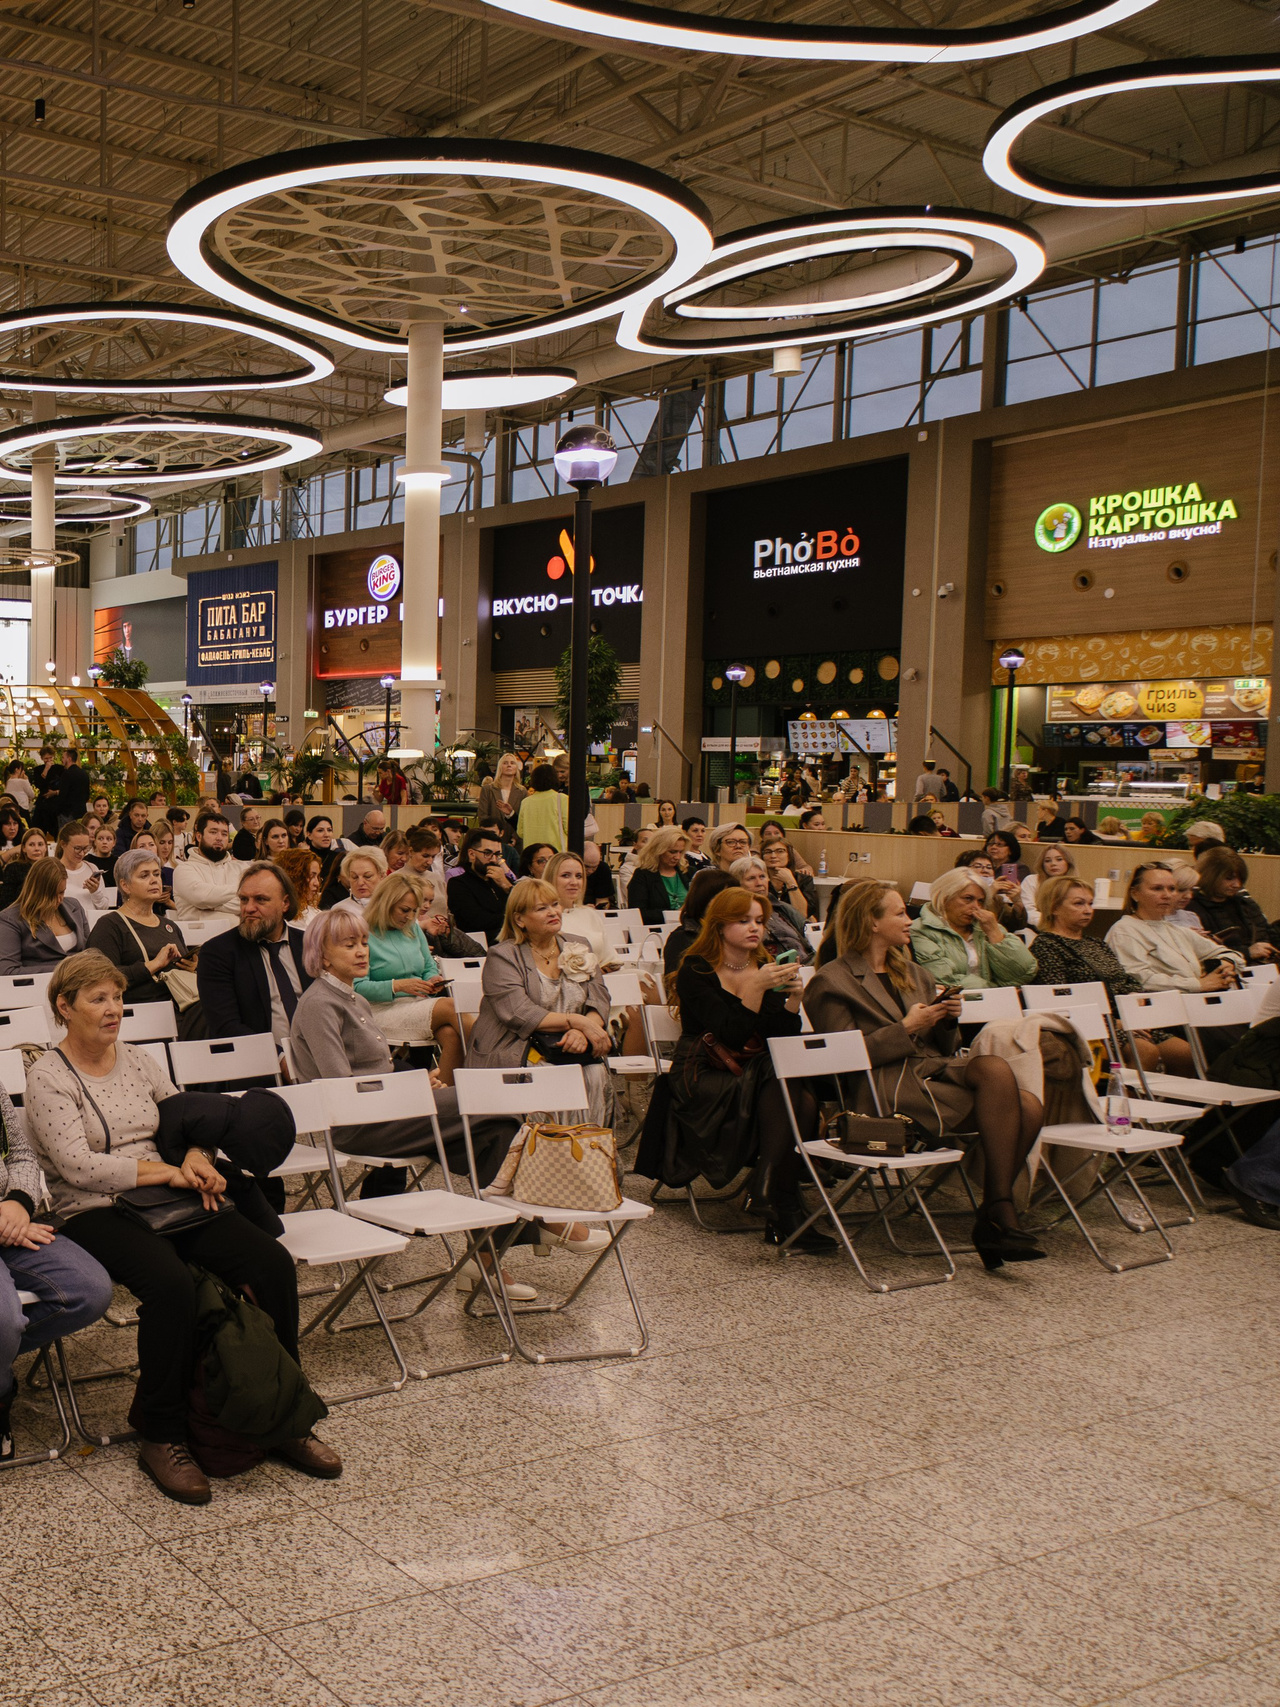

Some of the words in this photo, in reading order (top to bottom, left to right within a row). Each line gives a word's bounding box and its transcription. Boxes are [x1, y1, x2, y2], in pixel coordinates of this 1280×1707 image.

[1089, 482, 1202, 517] КРОШКА
[1088, 499, 1238, 537] КАРТОШКА
[1087, 530, 1166, 550] Натурально
[1169, 521, 1222, 541] вкусно!
[371, 562, 395, 581] BURGER
[753, 561, 825, 579] вьетнамская
[826, 557, 861, 573] кухня
[372, 569, 395, 591] KING
[207, 604, 237, 627] ПИТА
[241, 601, 266, 624] БАР
[324, 604, 388, 628] БУРГЕР
[492, 593, 558, 617] ВКУСНО
[207, 625, 266, 641] БАБАГАНУШ
[1146, 702, 1177, 714] чиз
[1147, 689, 1197, 704] гриль
